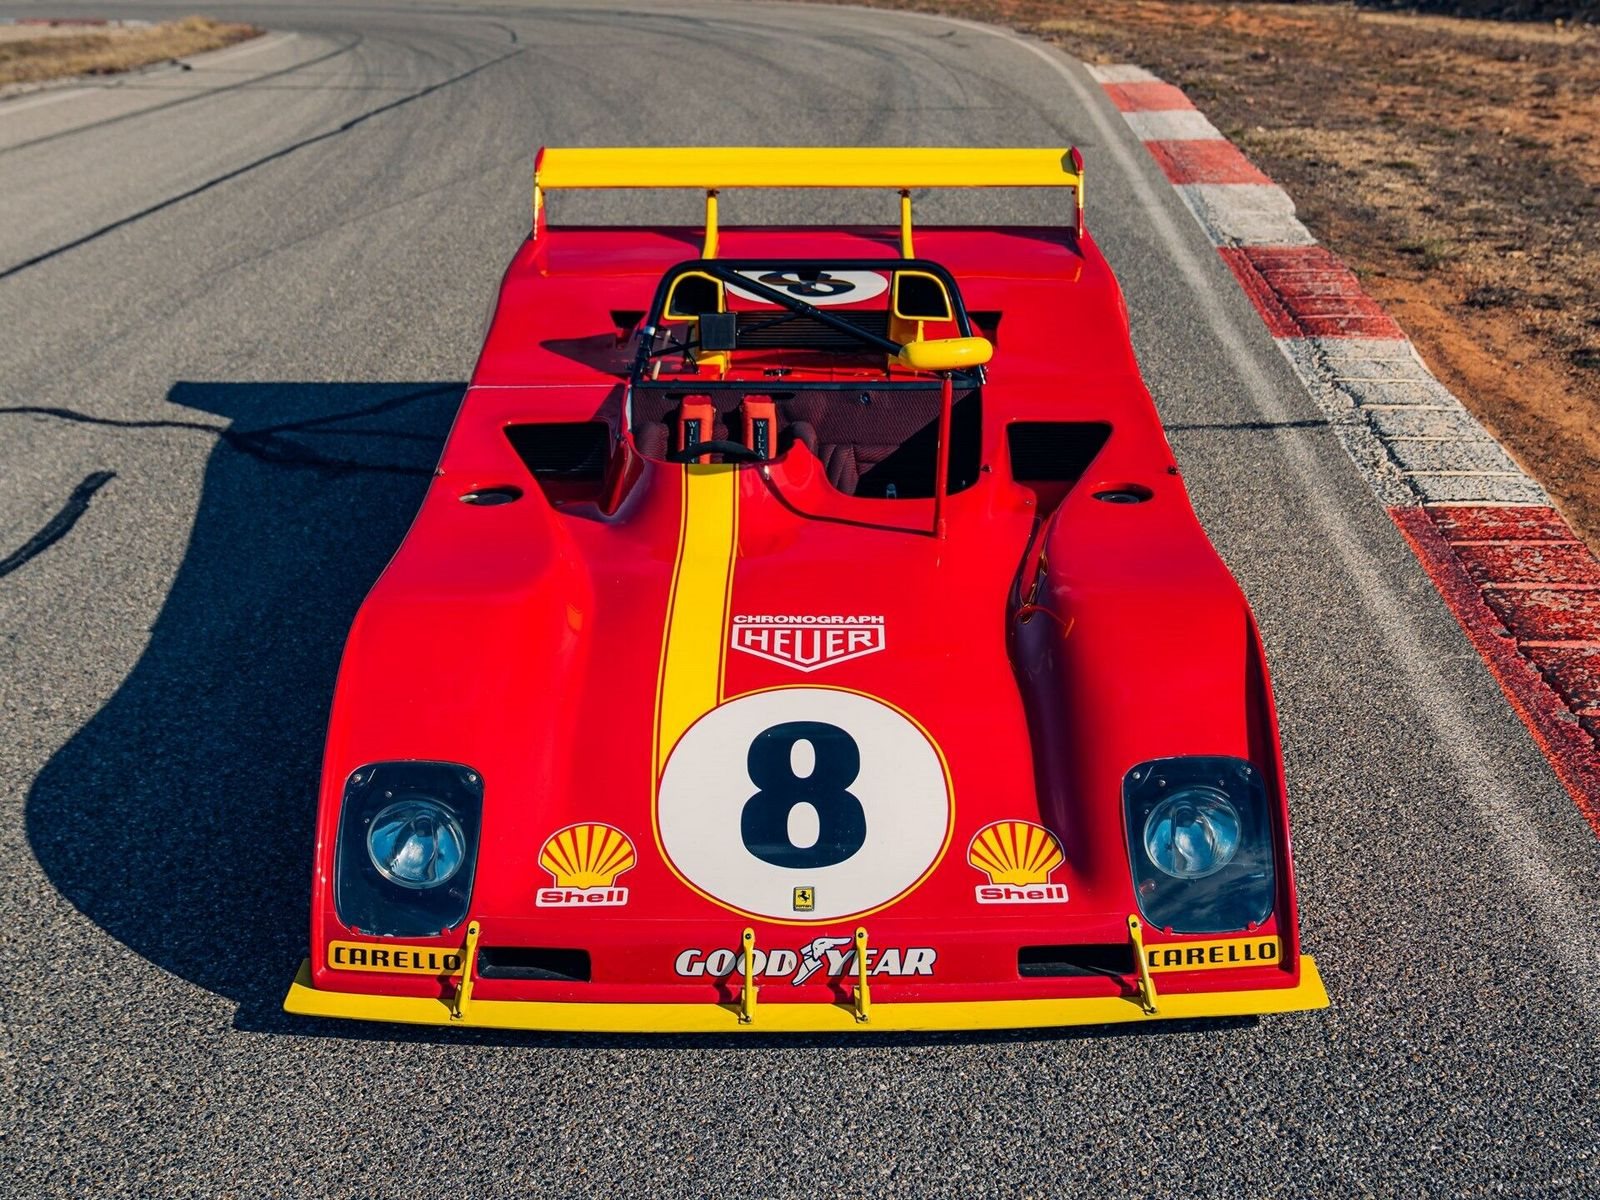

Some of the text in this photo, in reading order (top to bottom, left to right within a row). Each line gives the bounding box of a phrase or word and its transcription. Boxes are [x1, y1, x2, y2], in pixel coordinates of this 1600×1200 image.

[756, 421, 767, 461] WILLA
[733, 615, 885, 624] CHRONOGRAPH
[744, 629, 874, 665] HEUER
[740, 720, 867, 869] 8
[541, 890, 625, 903] Shell
[980, 887, 1065, 900] Shell
[334, 946, 461, 971] CARELLO
[1148, 942, 1276, 967] CARELLO
